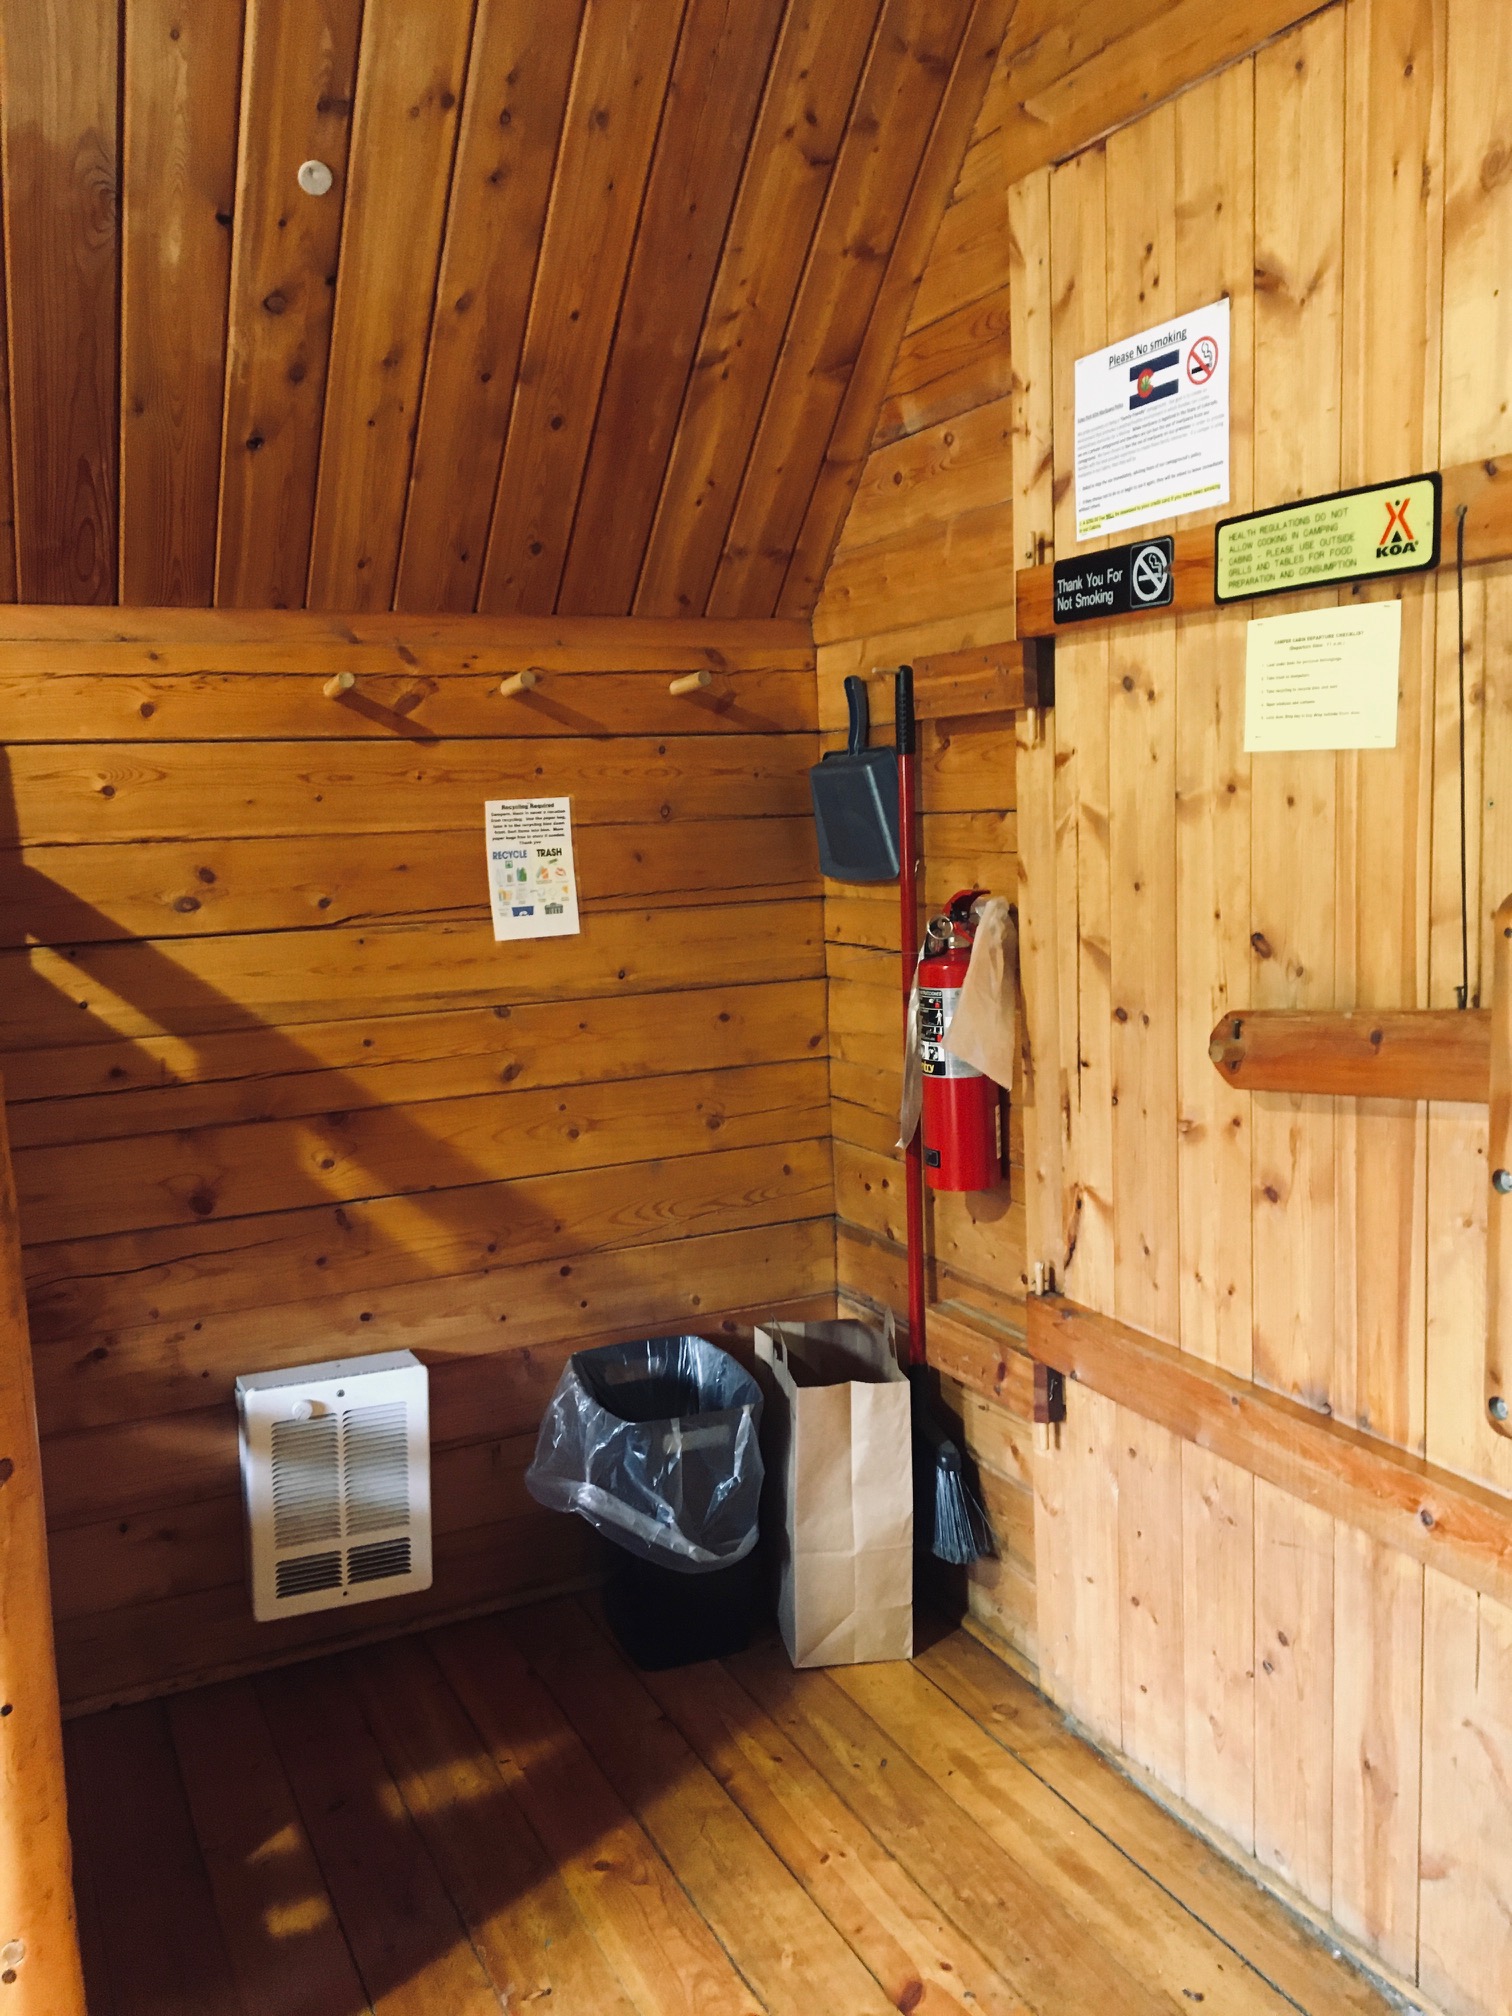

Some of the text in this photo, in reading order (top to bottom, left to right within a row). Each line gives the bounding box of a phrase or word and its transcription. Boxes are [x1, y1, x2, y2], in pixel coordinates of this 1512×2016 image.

[1109, 329, 1187, 367] Please No smoking
[1229, 507, 1349, 541] HEALTH REGULATIONS DO NOT
[1229, 522, 1338, 554] ALLOW COOKING IN CAMPING
[1229, 554, 1253, 566] CABINS
[1266, 544, 1294, 558] PLEASE
[1299, 540, 1314, 551] USE
[1320, 532, 1355, 547] OUTSIDE
[1229, 545, 1353, 577] GRILLS AND TABLES FOR FOOD
[1376, 542, 1416, 558] KOA
[1057, 568, 1123, 594] Thank You For
[1228, 558, 1357, 589] PREPARATION AND CONSUMPTION
[1057, 589, 1113, 611] Not Smoking
[492, 850, 527, 860] RECYCLE
[537, 848, 562, 857] TRASH
